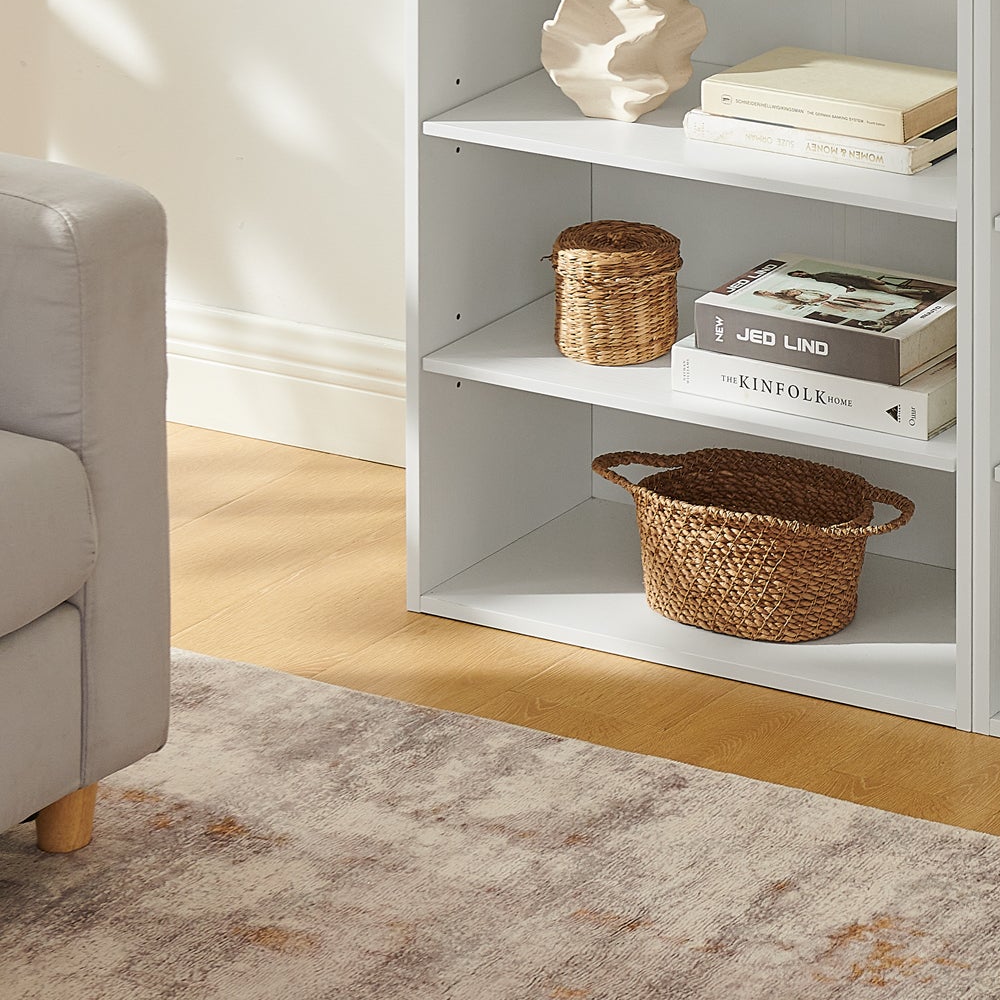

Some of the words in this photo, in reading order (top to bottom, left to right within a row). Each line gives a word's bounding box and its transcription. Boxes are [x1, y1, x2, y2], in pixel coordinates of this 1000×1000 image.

[805, 142, 839, 156] MONEY
[840, 148, 847, 156] &
[848, 150, 885, 165] WOMEN
[726, 278, 751, 294] JED
[715, 315, 725, 343] NEW
[736, 327, 776, 347] JED
[783, 335, 829, 356] LIND
[721, 374, 738, 385] THE
[738, 374, 827, 405] KINFOLK
[827, 395, 853, 408] HOME
